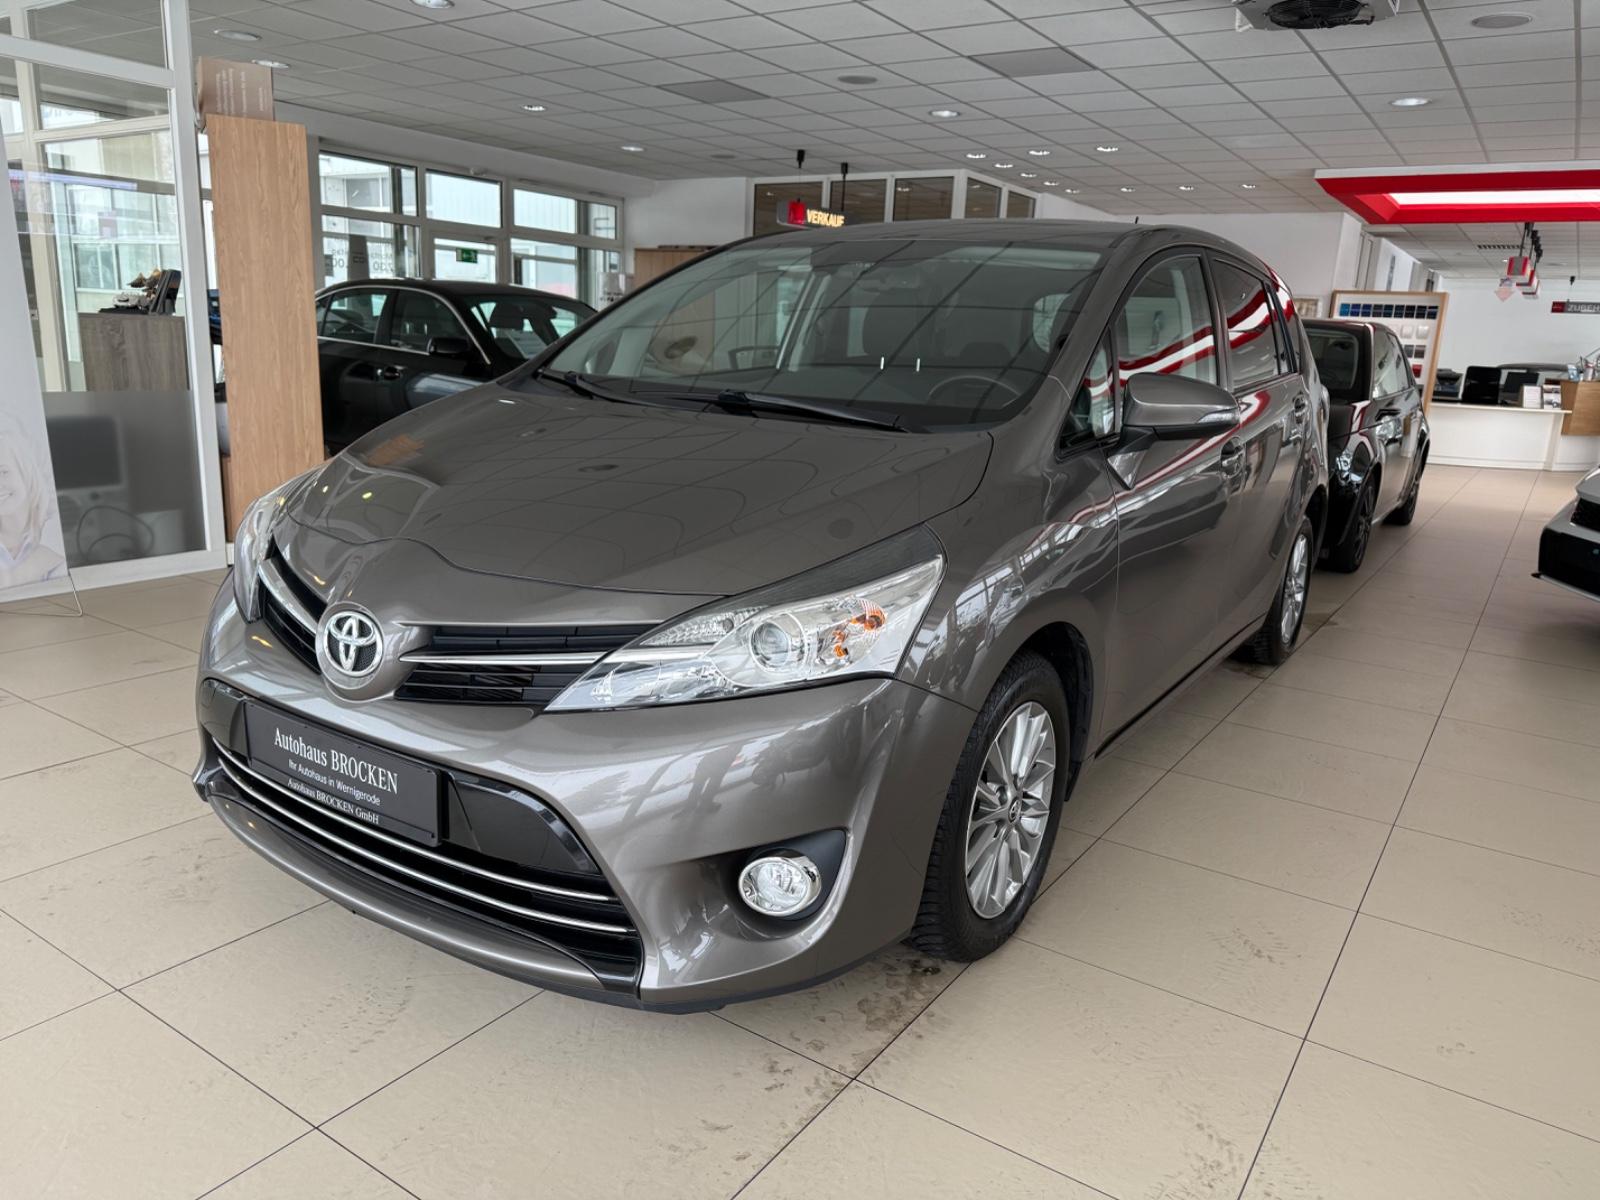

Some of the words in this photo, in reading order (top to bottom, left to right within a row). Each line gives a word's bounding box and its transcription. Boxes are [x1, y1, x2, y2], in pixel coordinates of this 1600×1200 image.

[807, 208, 845, 228] VERKAUF
[274, 728, 327, 767] Autohaus
[331, 750, 398, 794] BROCKEN
[289, 759, 297, 771] Ihr
[298, 764, 327, 785] Autohaus
[328, 778, 335, 788] in
[336, 780, 380, 806] Wernigerode
[288, 778, 315, 798] Autohaus
[316, 790, 354, 815] BROCKEN
[355, 809, 379, 825] GmbH
